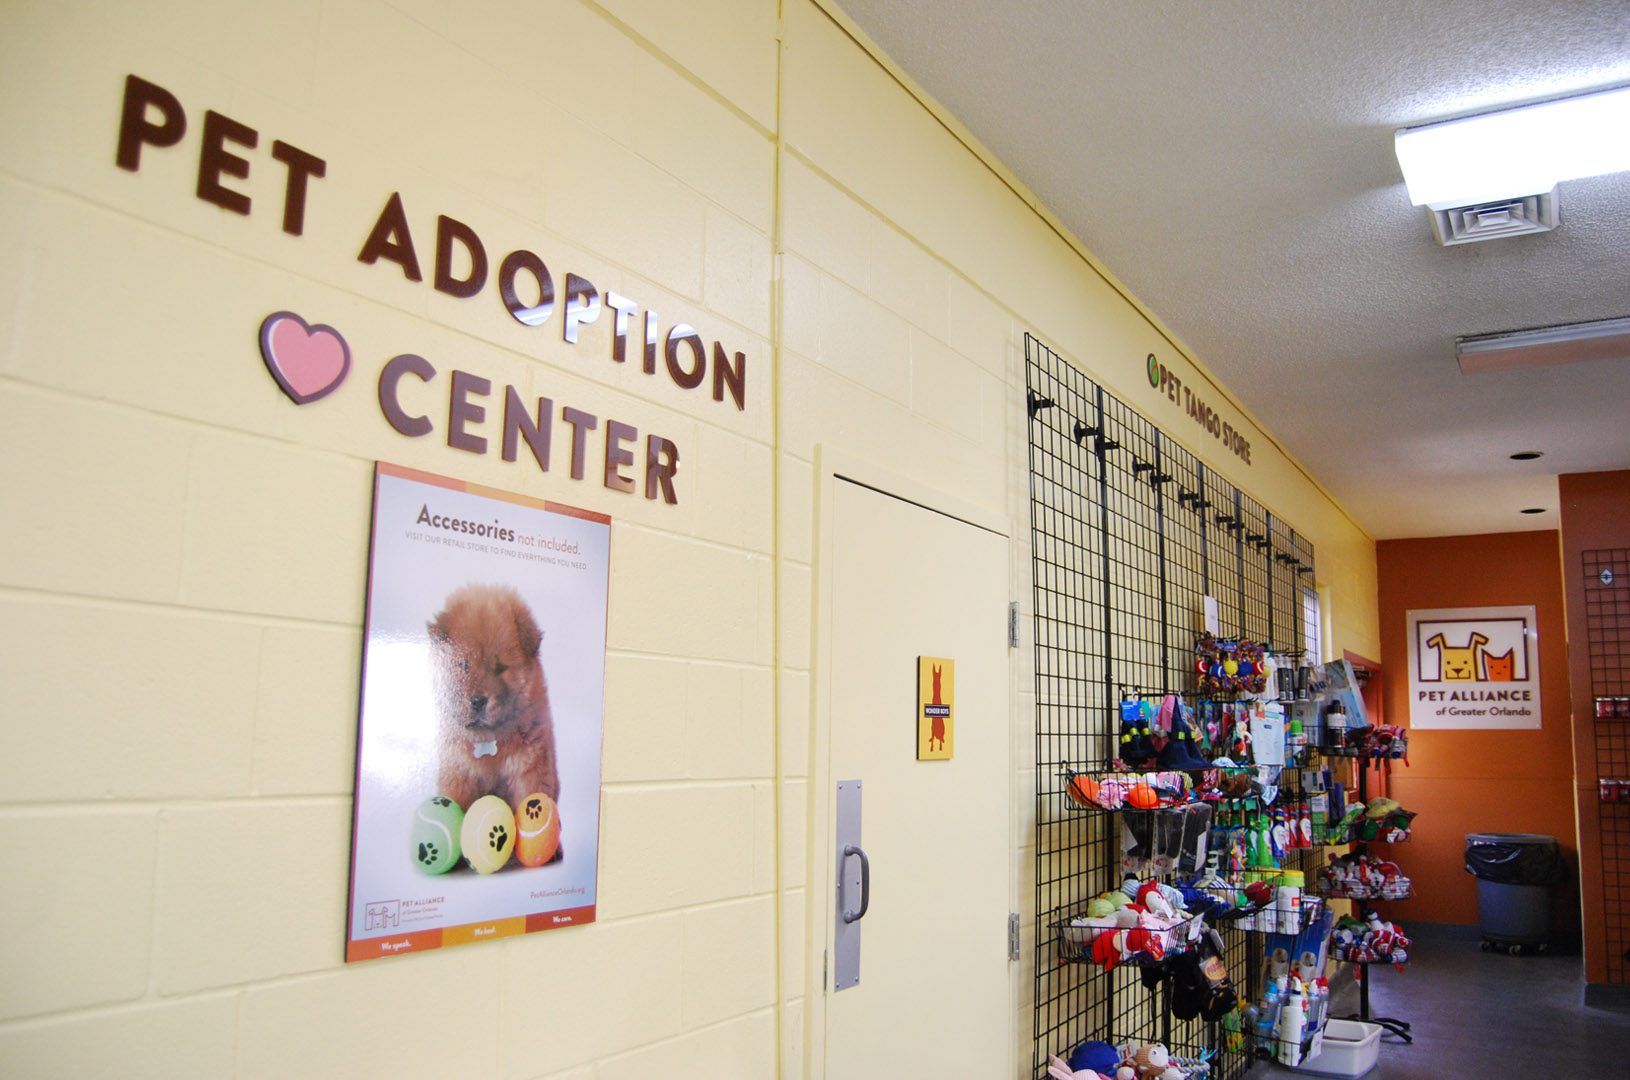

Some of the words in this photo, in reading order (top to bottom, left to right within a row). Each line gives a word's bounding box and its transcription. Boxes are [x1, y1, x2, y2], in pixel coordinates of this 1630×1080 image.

[115, 73, 326, 237] PET
[357, 191, 746, 412] ADOPTION
[378, 353, 680, 505] CENTER
[1160, 363, 1181, 407] PET
[1184, 386, 1221, 439] TANGO
[1222, 421, 1251, 466] STORE
[416, 503, 515, 543] Accessories
[517, 534, 535, 547] not
[538, 533, 581, 556] included.
[405, 530, 423, 540] VISIT
[425, 534, 441, 543] OUR
[442, 537, 465, 549] RETAIL
[467, 542, 488, 553] STORE
[490, 545, 500, 554] TO
[500, 548, 516, 558] FIND
[517, 551, 556, 565] EVERYTHING
[557, 558, 570, 567] YOU
[570, 561, 586, 570] NEED
[1418, 690, 1446, 702] PET
[1450, 690, 1531, 702] ALLIANCE
[1435, 706, 1446, 716] of
[1448, 706, 1486, 716] Greater
[1489, 706, 1531, 716] Orlando
[414, 896, 445, 905] ALLIANCE
[381, 941, 392, 950] We
